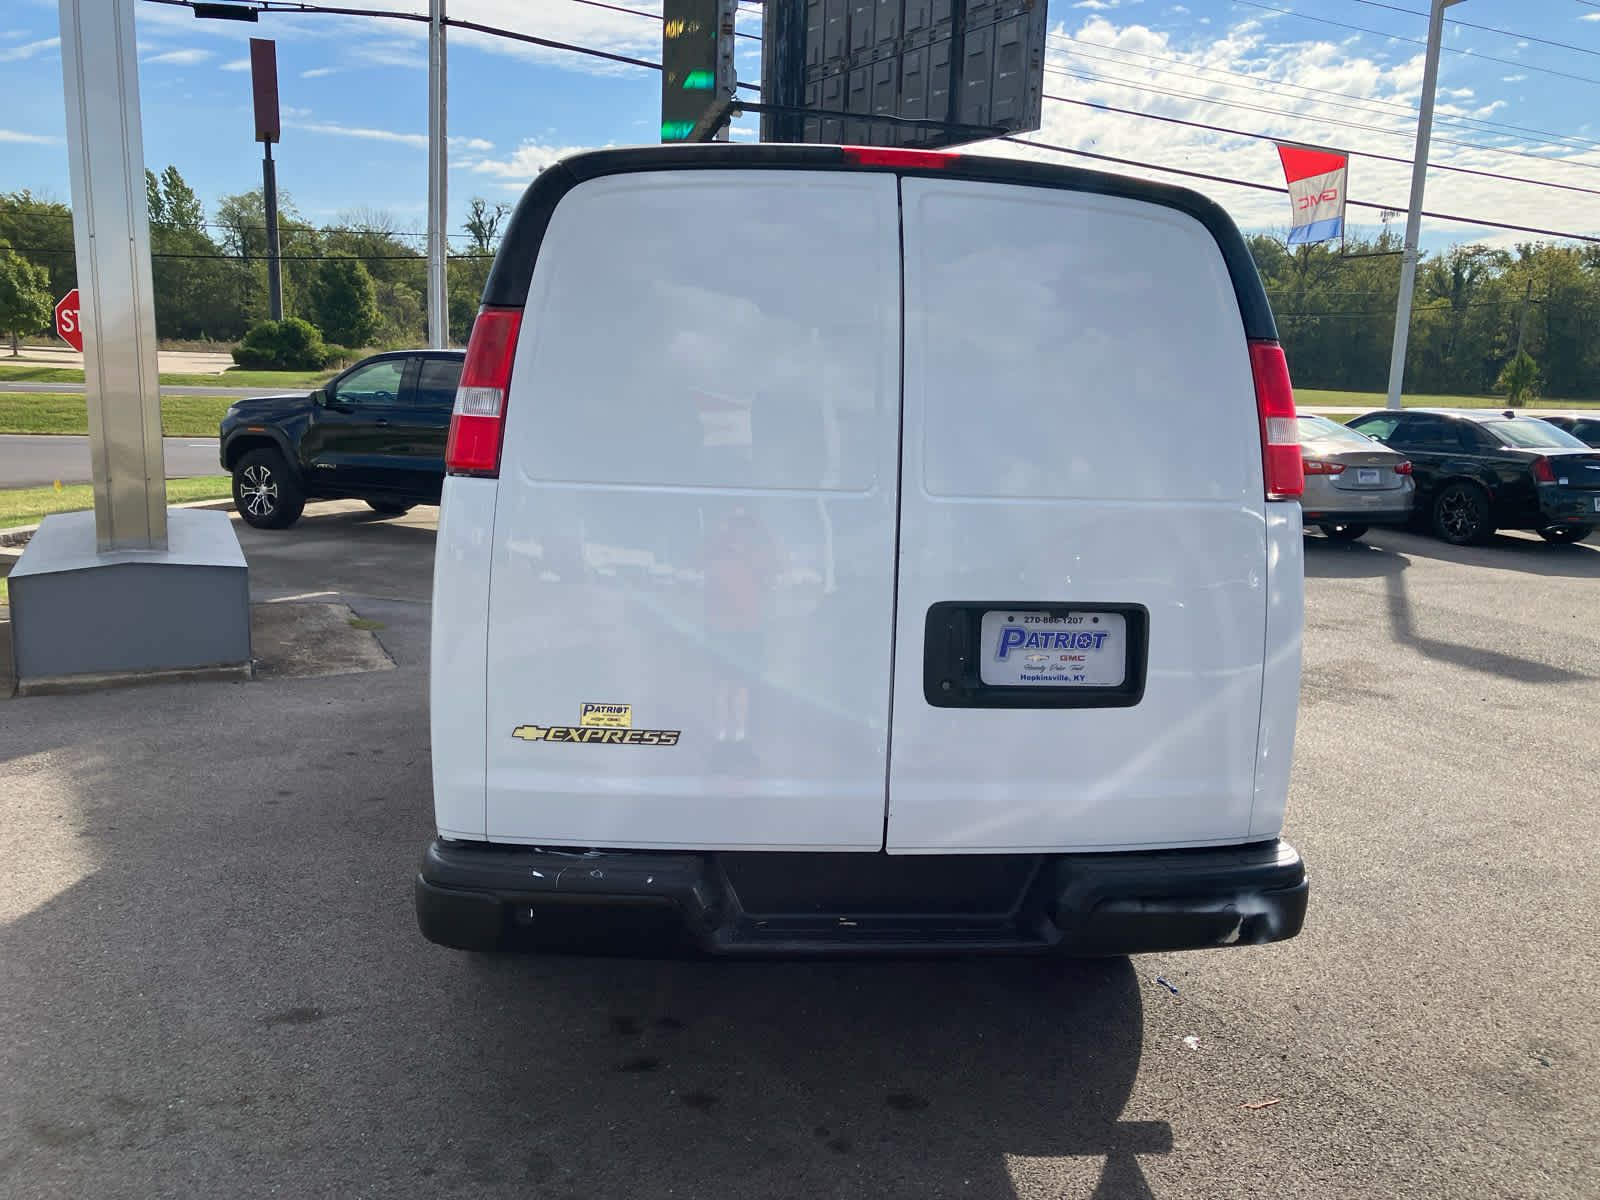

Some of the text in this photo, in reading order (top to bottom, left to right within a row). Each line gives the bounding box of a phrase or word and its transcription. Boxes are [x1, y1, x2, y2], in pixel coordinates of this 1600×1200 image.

[61, 308, 82, 333] ST
[997, 627, 1108, 659] PATRIOT
[1059, 654, 1086, 662] GMC
[1020, 673, 1086, 682] Hopkinsville, KY
[583, 703, 630, 717] PATRIOT
[546, 727, 681, 746] EXPRESS
